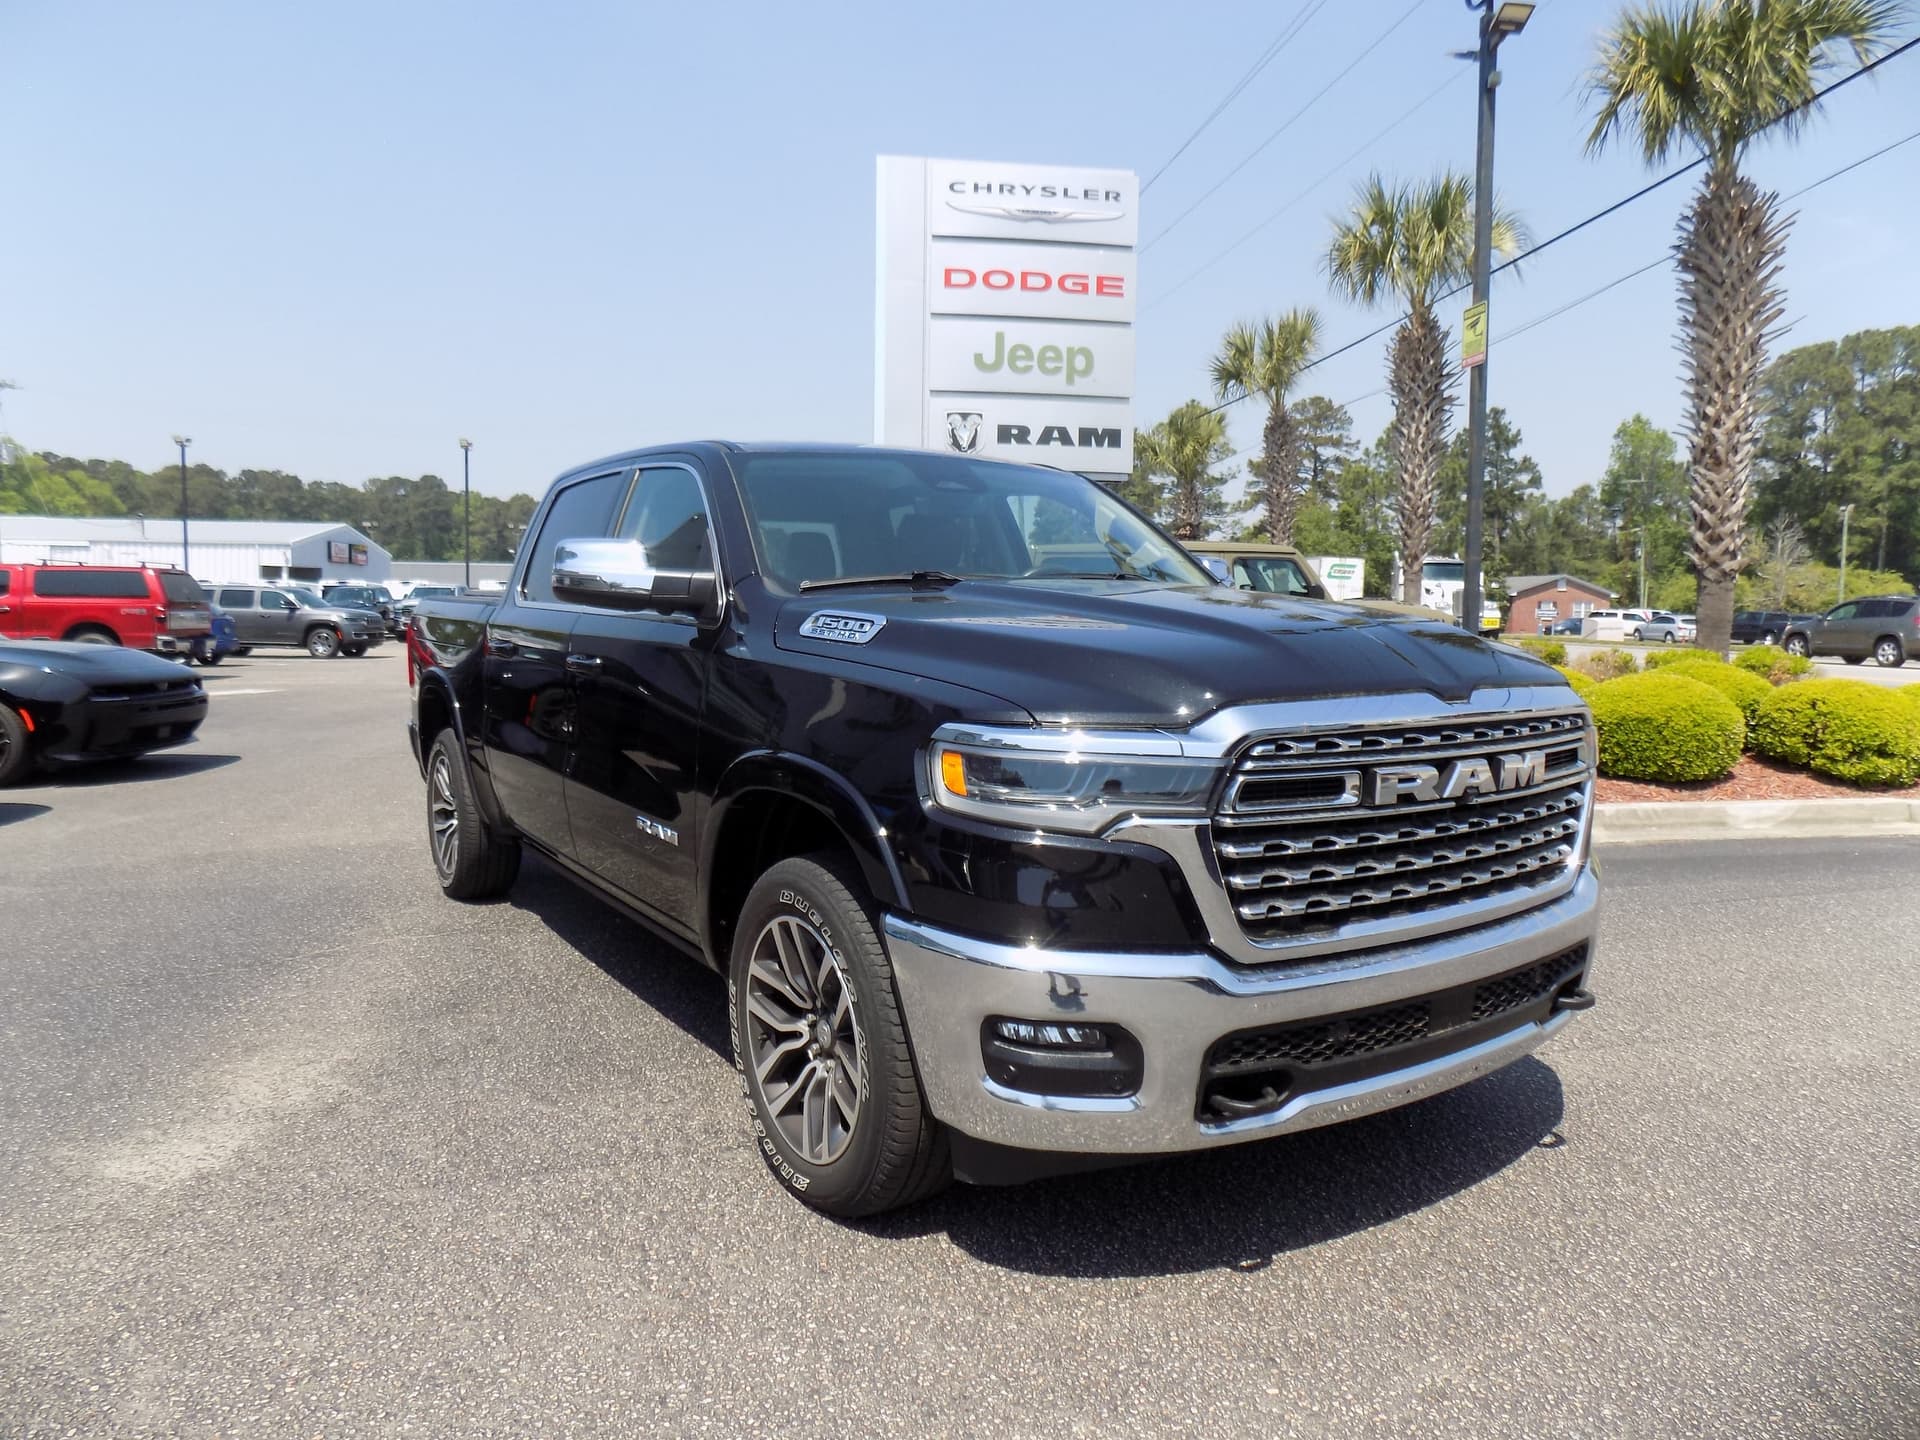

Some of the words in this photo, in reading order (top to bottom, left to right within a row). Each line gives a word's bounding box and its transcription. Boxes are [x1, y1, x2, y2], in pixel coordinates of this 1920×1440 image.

[948, 181, 1122, 202] CHRYSLER
[943, 267, 1125, 299] DODGE
[973, 331, 1095, 386] Jeep
[996, 423, 1122, 449] RAM
[816, 616, 871, 632] 1500
[1370, 750, 1546, 807] RAM
[635, 815, 679, 847] RAM
